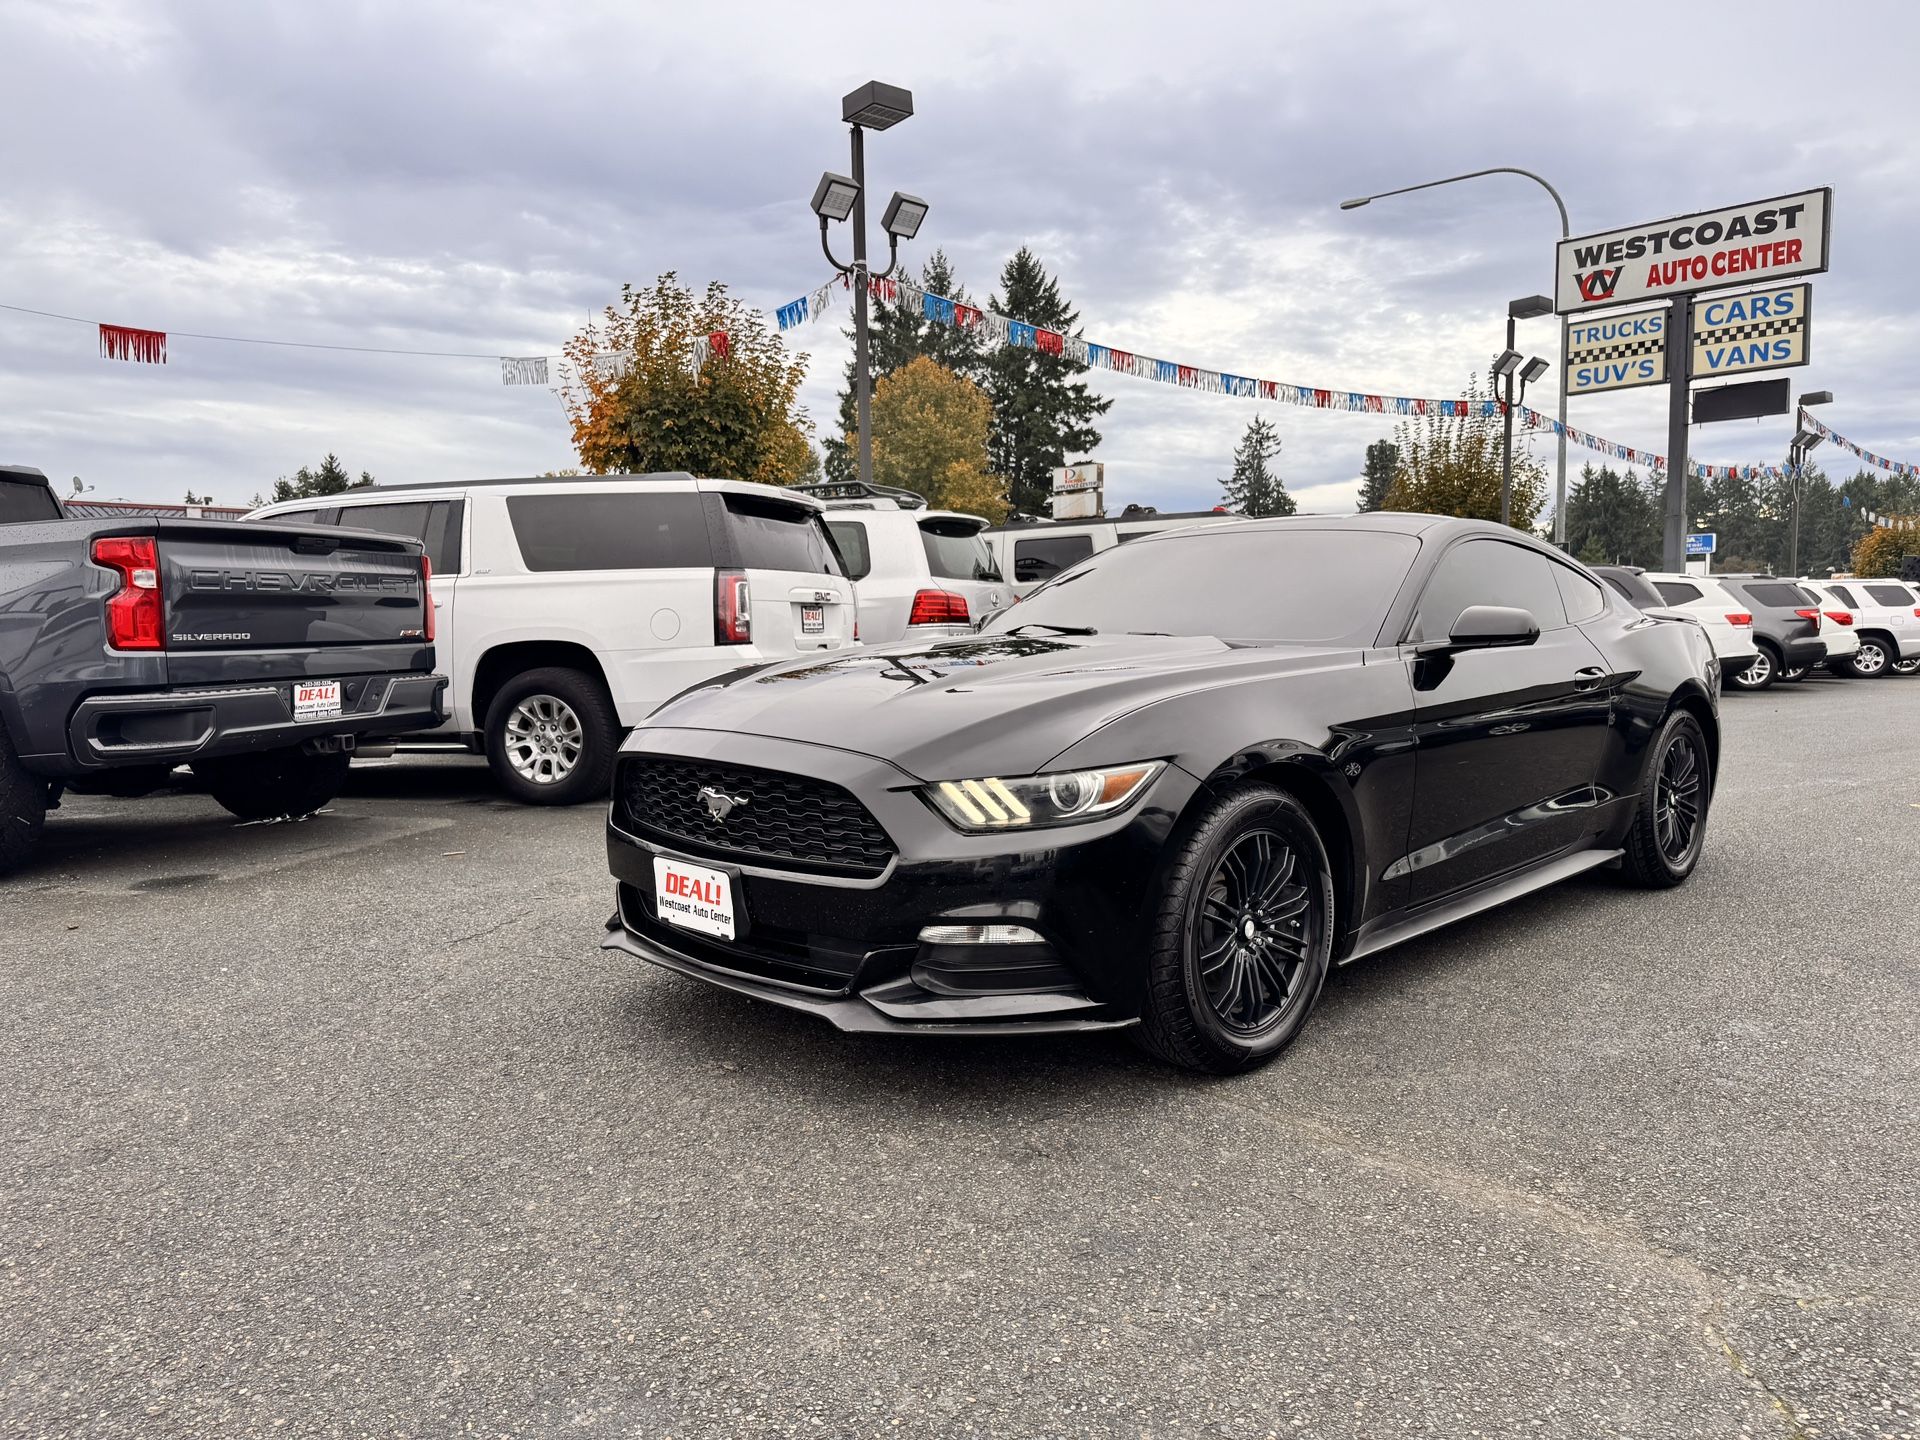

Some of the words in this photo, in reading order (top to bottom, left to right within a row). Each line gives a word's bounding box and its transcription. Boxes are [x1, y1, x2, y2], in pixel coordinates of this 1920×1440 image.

[1573, 203, 1805, 269] WESTCOAST
[1646, 255, 1708, 289] AUTO
[1711, 238, 1803, 276] CENTER
[1704, 292, 1795, 326] CARS
[1573, 316, 1663, 345] TRUCKS
[1705, 339, 1792, 369] VANS
[1576, 359, 1655, 387] SUV'S
[191, 570, 417, 594] CHEVROLET
[814, 591, 831, 601] GMC
[804, 611, 821, 621] DEAL!
[172, 632, 251, 641] SILVERADO
[299, 687, 335, 702] DEAL!
[665, 872, 721, 906] DEAL!
[659, 896, 691, 914] Westcoast
[693, 905, 709, 919] Auto
[710, 909, 732, 924] Center
